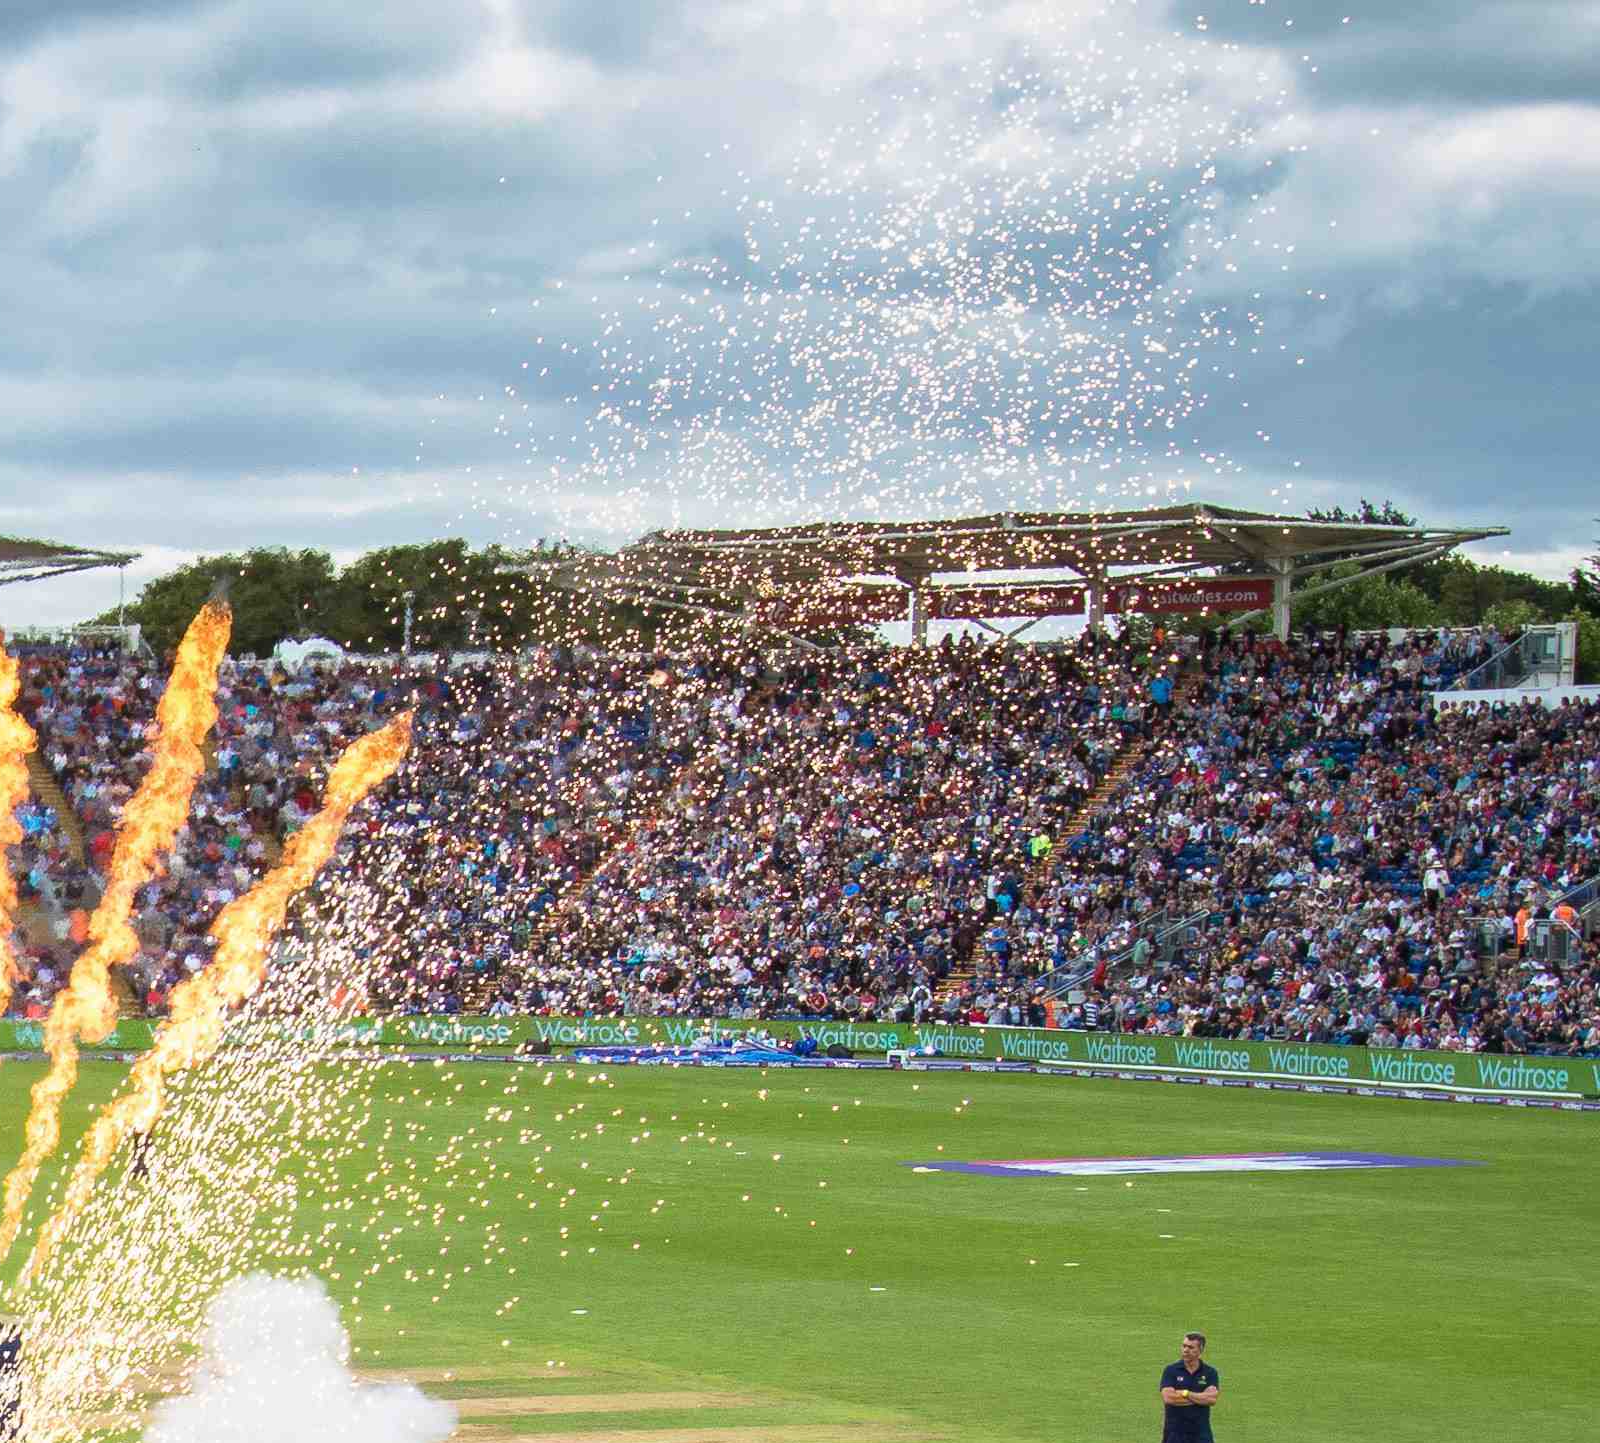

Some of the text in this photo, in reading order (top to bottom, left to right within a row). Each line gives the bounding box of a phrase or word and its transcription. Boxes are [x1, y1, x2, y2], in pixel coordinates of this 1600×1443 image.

[1147, 589, 1259, 607] vsitwales.com
[408, 1019, 510, 1043] Waitrose
[535, 1020, 639, 1044] Waitrose
[918, 1027, 985, 1054] Waitrose
[1001, 1031, 1069, 1059] Waitrose
[1086, 1036, 1156, 1064] Waitrose
[1175, 1040, 1251, 1070] Waitrose
[1269, 1045, 1349, 1076] Waitrose
[1369, 1052, 1456, 1084] Waitrose
[1478, 1058, 1569, 1089] Waitrose
